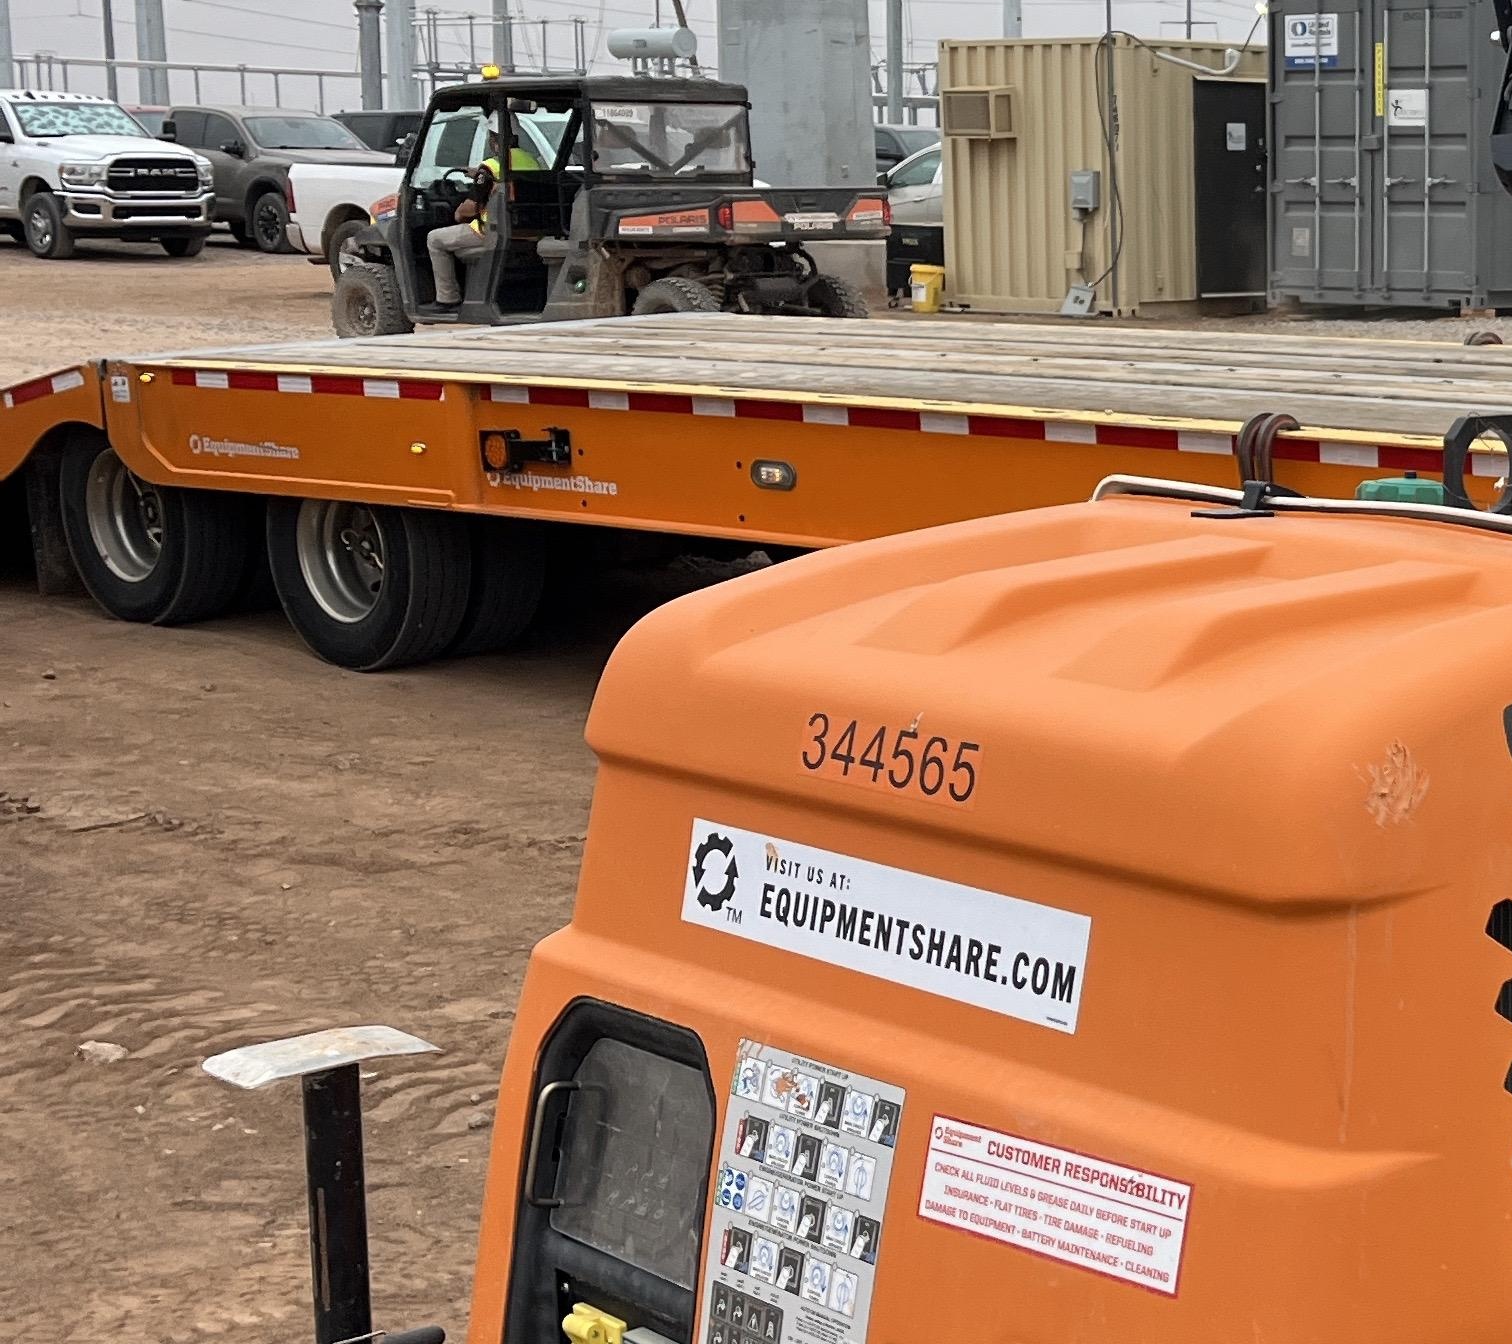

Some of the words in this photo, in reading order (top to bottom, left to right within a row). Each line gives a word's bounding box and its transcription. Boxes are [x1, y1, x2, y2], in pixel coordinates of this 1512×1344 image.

[137, 168, 176, 177] RAM
[503, 470, 618, 496] EquipmentShare
[802, 712, 980, 803] 344565
[766, 854, 801, 879] VISIT
[806, 866, 824, 885] US
[829, 873, 851, 892] AT:
[759, 883, 1078, 1004] EQUIPMENTSHARE.COM
[934, 1161, 959, 1178] CHECK
[960, 1168, 974, 1182] ALL
[975, 1173, 999, 1189] FLUID
[1000, 1180, 1028, 1198] LEVELS
[1037, 1191, 1068, 1210] GREASE
[1069, 1200, 1094, 1218] DAILY
[1095, 1208, 1128, 1228] BEFORE
[1130, 1218, 1157, 1236] START
[1158, 1226, 1172, 1240] UP
[987, 1140, 1060, 1174] CUSTOMER
[1063, 1160, 1185, 1210] RESPONSIBILITY
[924, 1198, 956, 1217] DAMAGE
[957, 1208, 968, 1221] TO
[969, 1212, 1015, 1236] EQUIPMENT
[1021, 1227, 1056, 1248] BATTERY
[1057, 1238, 1119, 1267] MAINTENANCE
[1124, 1259, 1169, 1283] CLEANING
[944, 1183, 989, 1207] INSURANCE
[993, 1198, 1012, 1214] FLAT
[1013, 1204, 1038, 1221] TIRES
[1043, 1213, 1062, 1229] TIRE
[1063, 1219, 1099, 1240] DAMAGE
[1104, 1231, 1153, 1256] REFUELING
